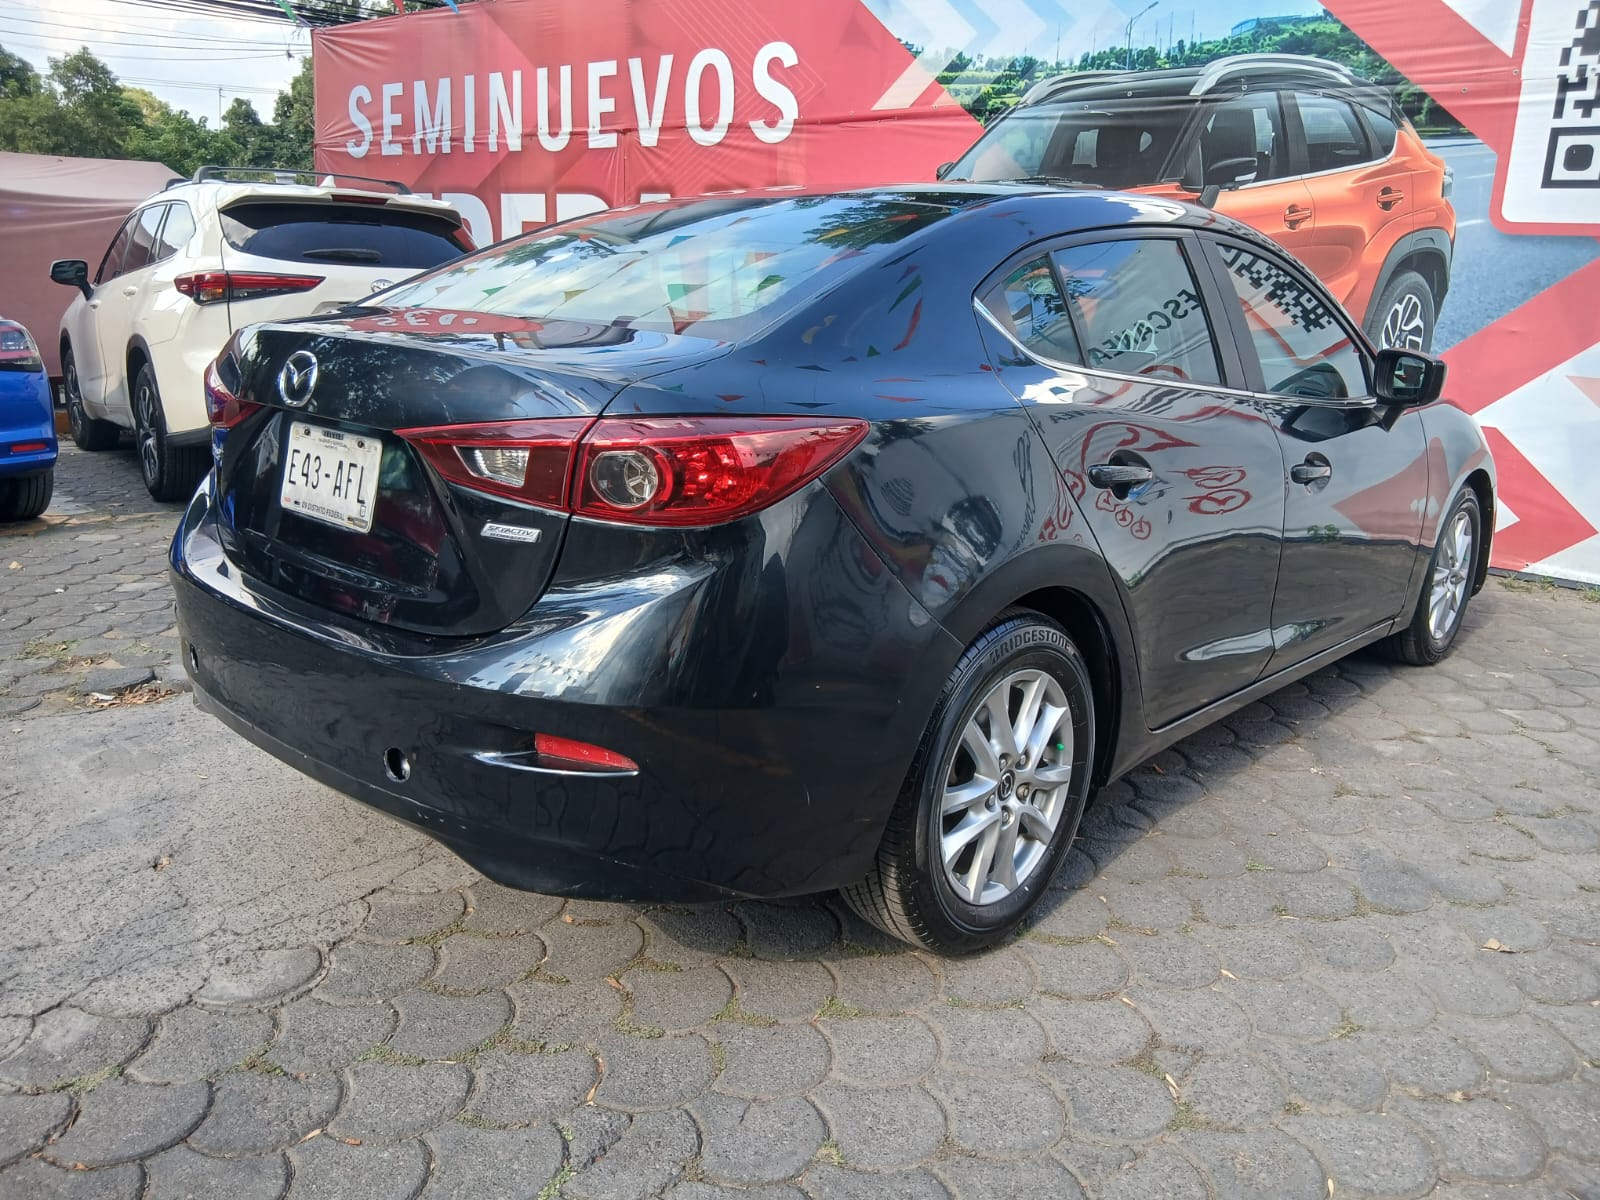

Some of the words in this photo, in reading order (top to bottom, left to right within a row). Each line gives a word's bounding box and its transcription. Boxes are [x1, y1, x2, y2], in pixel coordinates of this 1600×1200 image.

[346, 41, 799, 157] SEMINUEVOS
[288, 449, 365, 504] E43-AFL
[989, 629, 1070, 663] BRIDGESTONE
